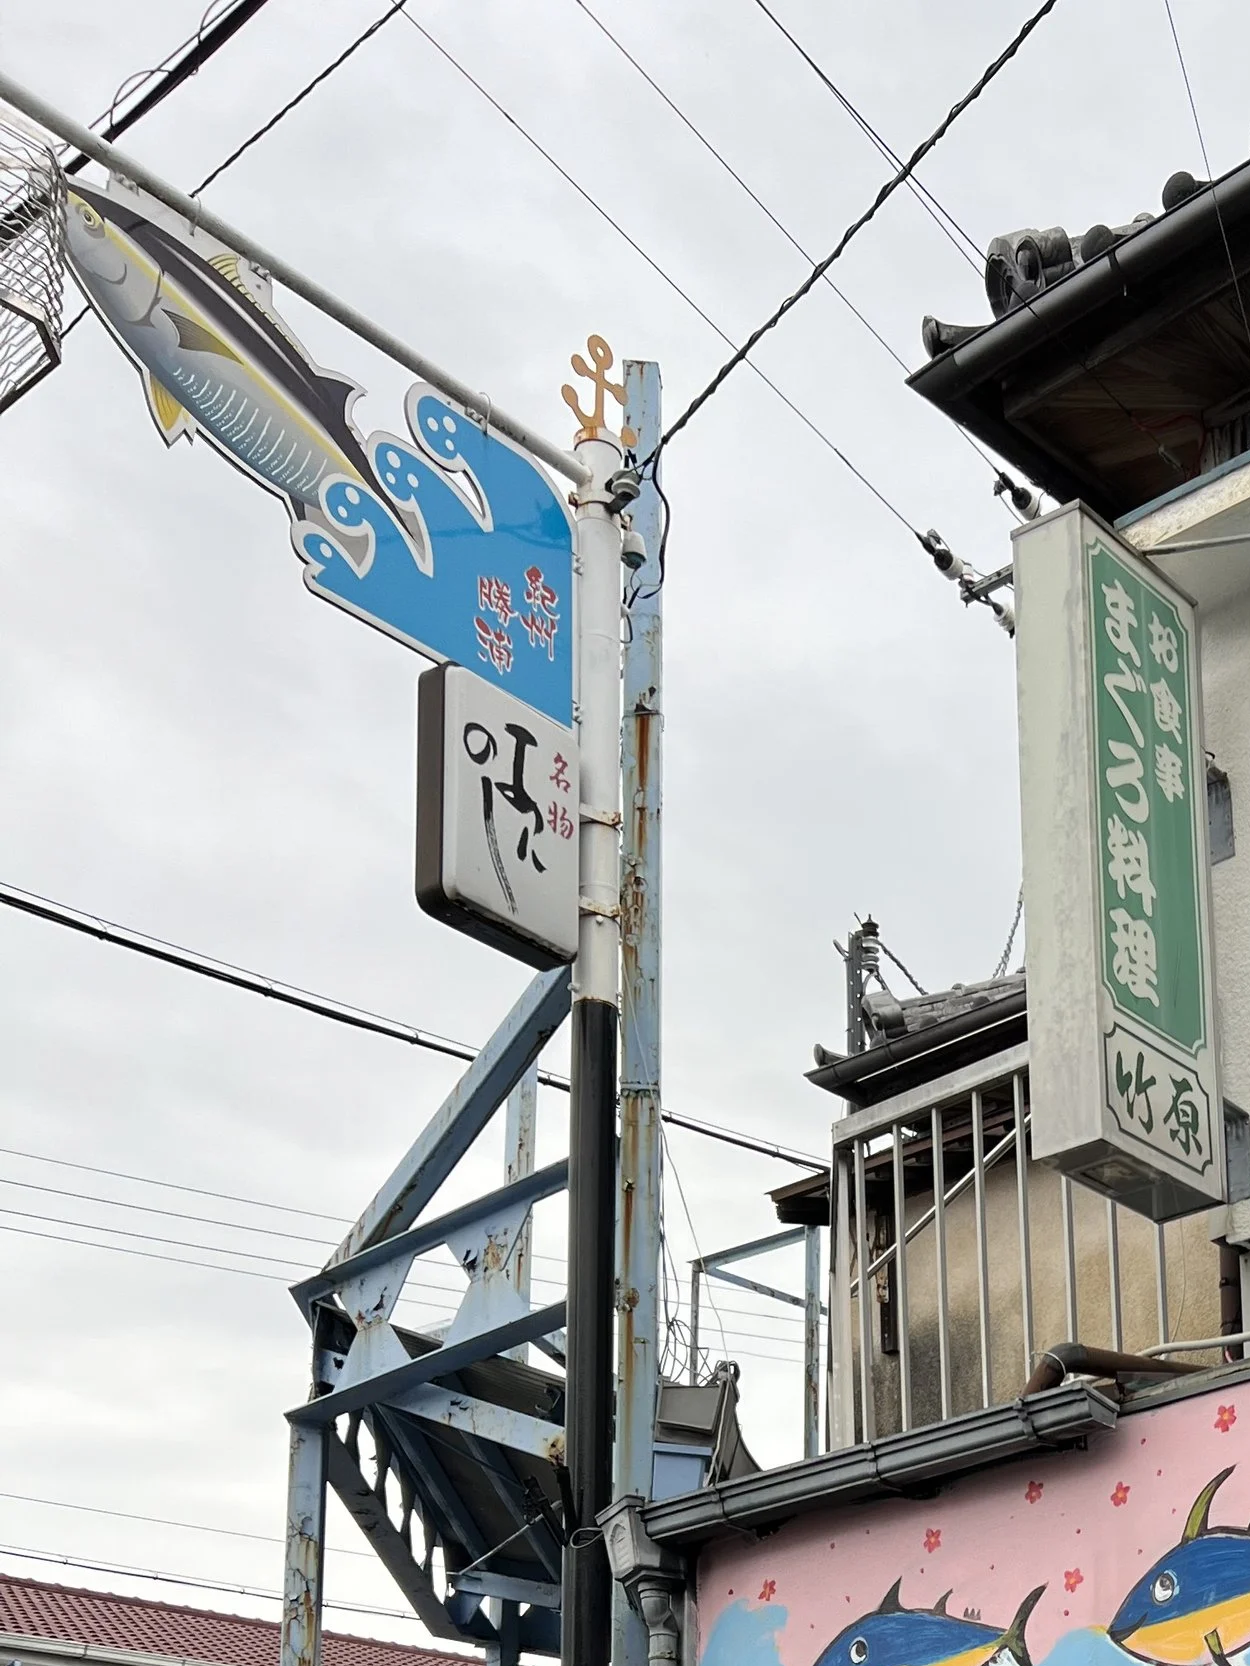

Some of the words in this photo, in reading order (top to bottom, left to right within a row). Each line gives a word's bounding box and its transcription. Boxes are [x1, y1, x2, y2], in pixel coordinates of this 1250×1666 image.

[1147, 612, 1186, 804] お食事
[547, 751, 575, 840] 名物
[1101, 578, 1161, 1008] まぐろ料理
[1115, 1050, 1203, 1156] 竹原
